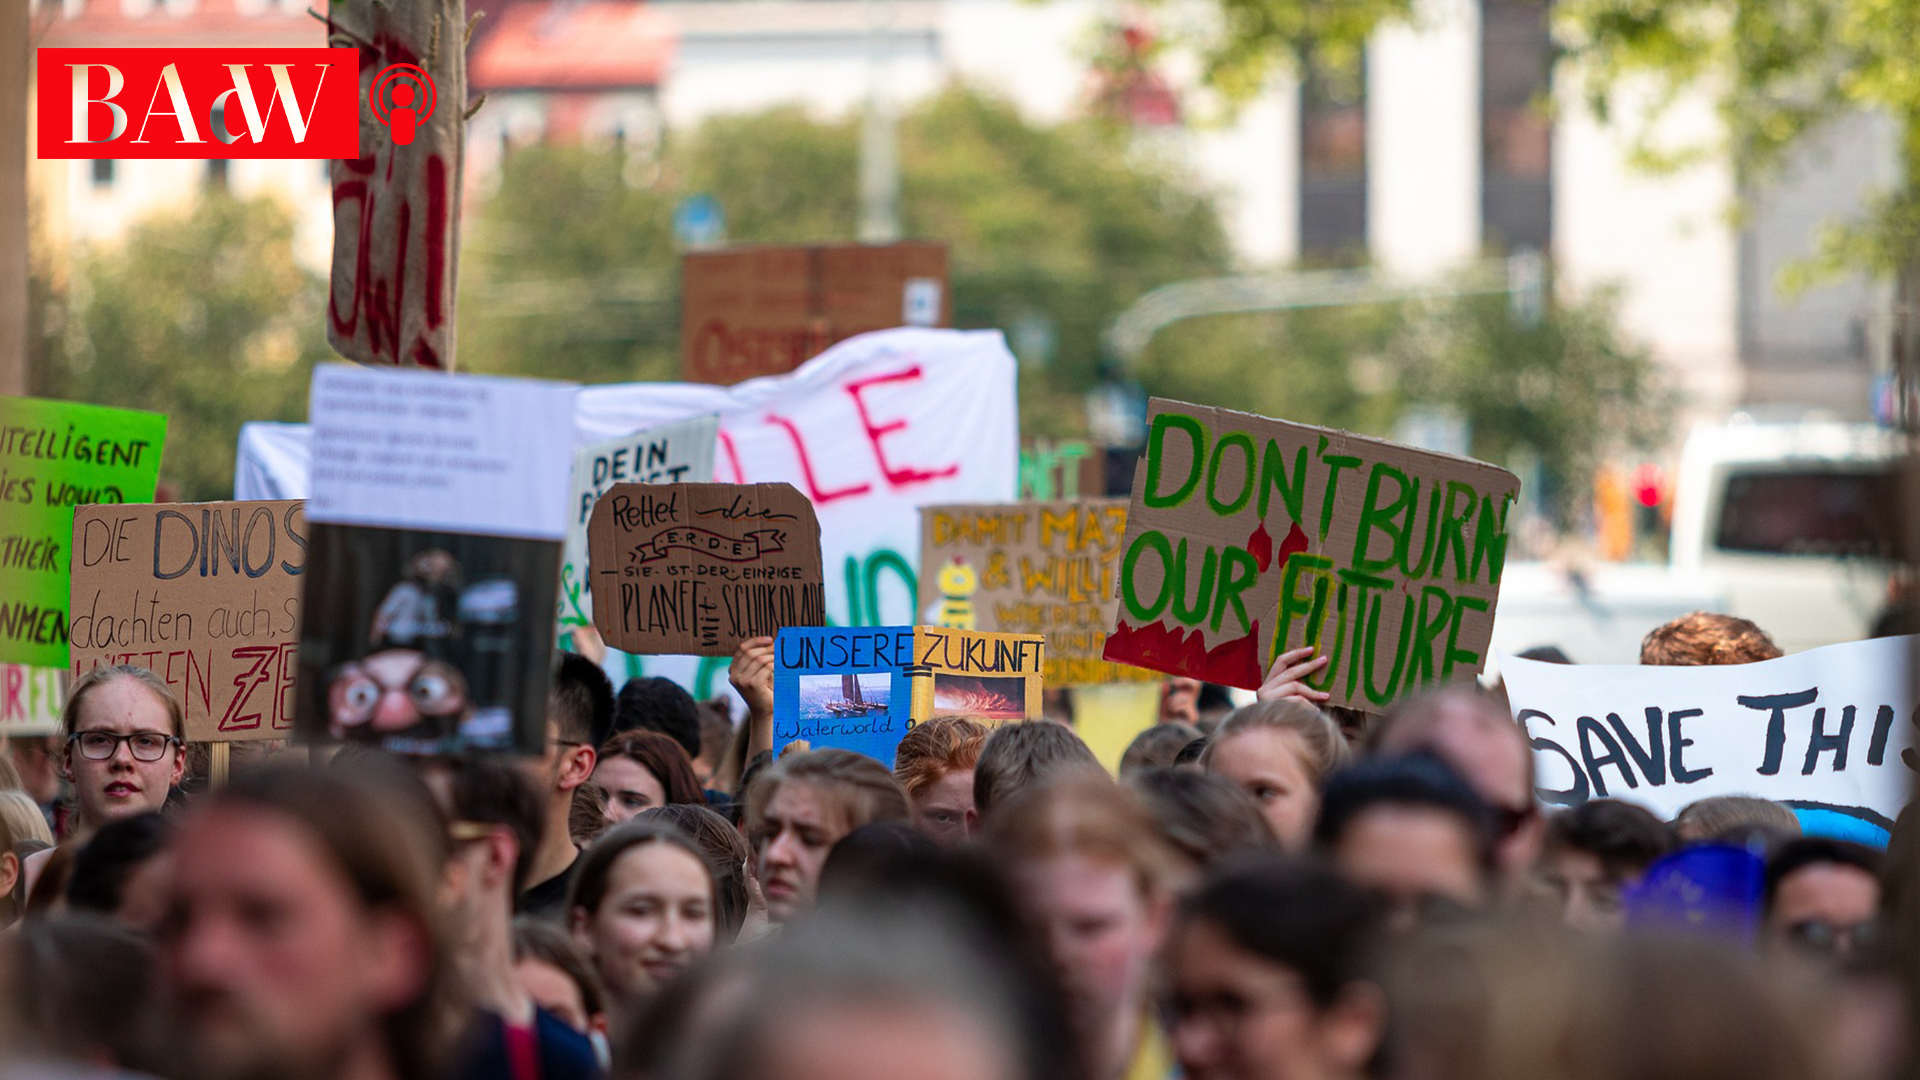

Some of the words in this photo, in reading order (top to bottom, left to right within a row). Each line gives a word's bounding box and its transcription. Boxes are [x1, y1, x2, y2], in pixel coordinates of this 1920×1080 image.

[592, 437, 669, 487] DEIN
[612, 491, 679, 532] Rettet
[695, 494, 798, 520] die
[1143, 413, 1363, 544] DON'T
[1352, 461, 1515, 586] BURN
[83, 516, 138, 567] DIE
[152, 503, 310, 580] DINOS
[932, 510, 1028, 547] DAMIT
[742, 566, 803, 580] EINZIGE
[981, 552, 1013, 592] &
[70, 590, 192, 650] dachten
[621, 580, 706, 638] PLANET
[699, 596, 721, 648] mit
[1121, 530, 1260, 634] OUR
[1267, 551, 1490, 706] FUTURE
[780, 632, 916, 670] UNSERE
[920, 632, 1045, 673] ZUKUNFT
[775, 717, 895, 739] Waterworld
[1516, 706, 1714, 806] SAVE
[1737, 686, 1920, 777] THI
